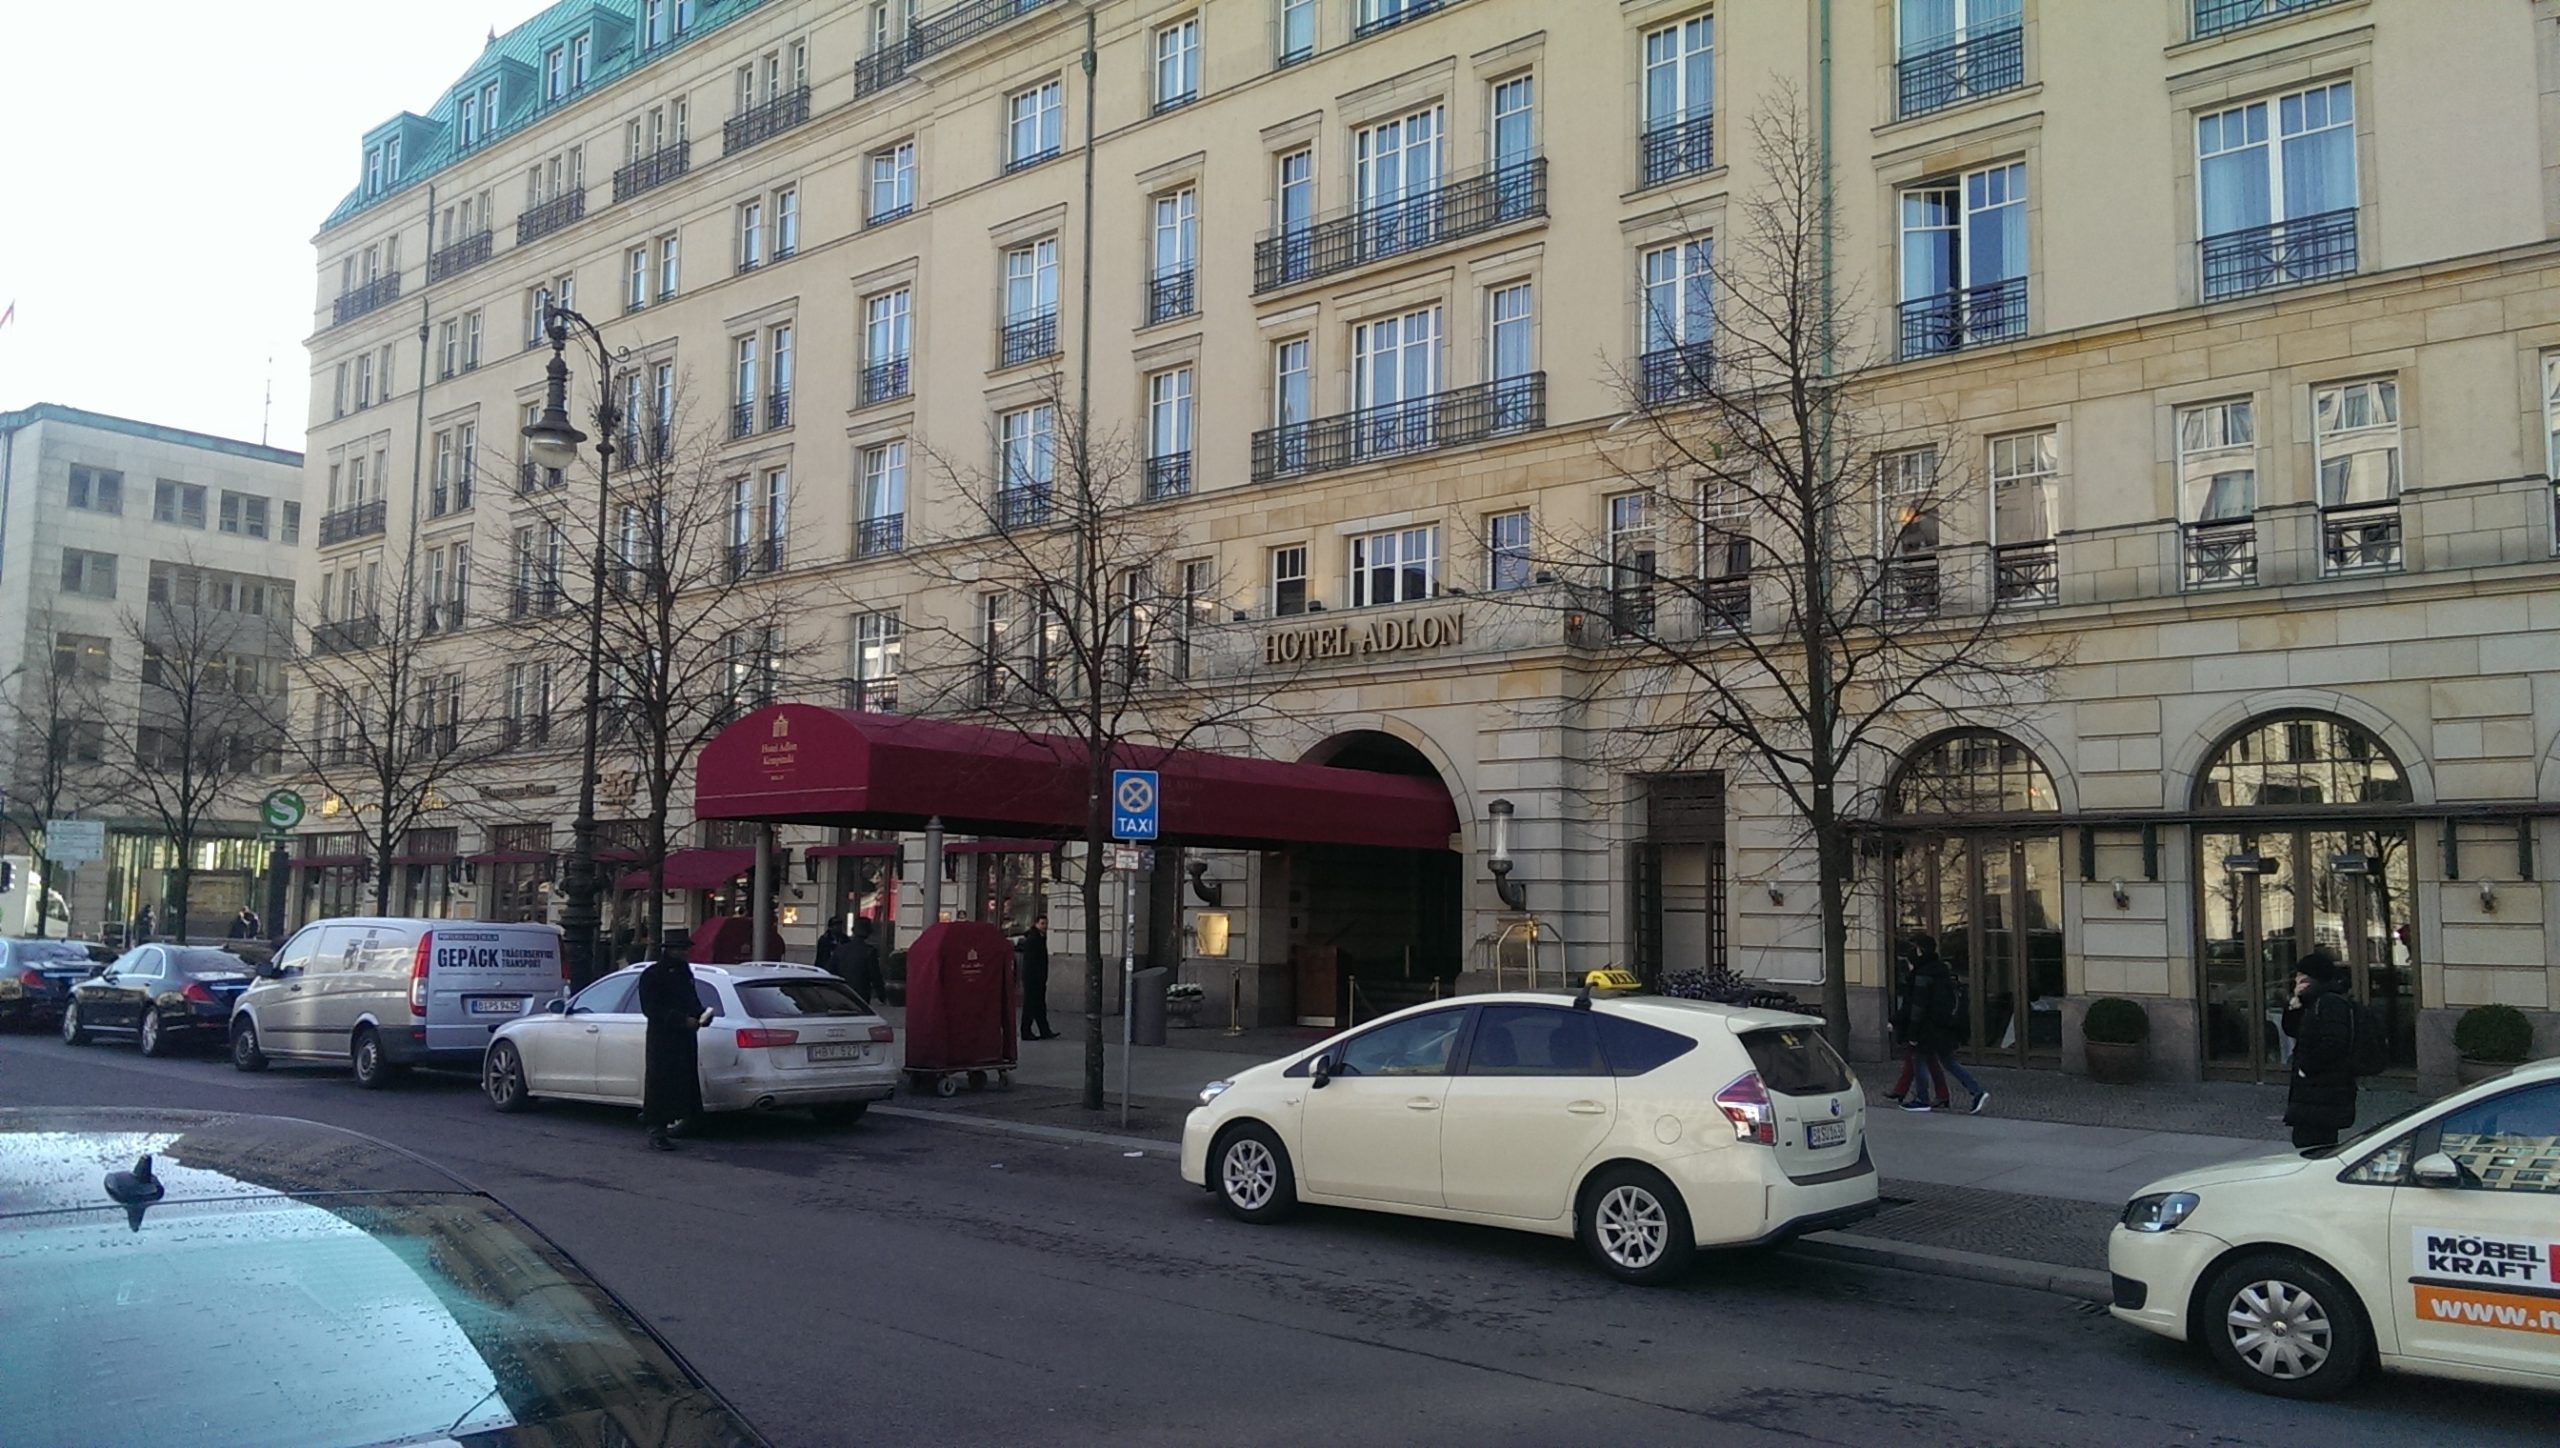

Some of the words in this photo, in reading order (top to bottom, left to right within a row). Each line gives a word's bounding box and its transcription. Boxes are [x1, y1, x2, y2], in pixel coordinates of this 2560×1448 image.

[1264, 626, 1350, 664] HOTEL
[1361, 613, 1464, 653] ADLON
[762, 743, 778, 753] Hotel
[779, 741, 798, 752] Adlon
[269, 791, 299, 826] S
[1118, 817, 1153, 833] TAXI
[438, 946, 499, 968] GEPÄCK
[502, 949, 554, 959] TRÄGERSERVICE
[502, 958, 542, 968] TRANSPORT
[2426, 1234, 2546, 1263] MÖBEL
[2428, 1254, 2538, 1280] KRAFT
